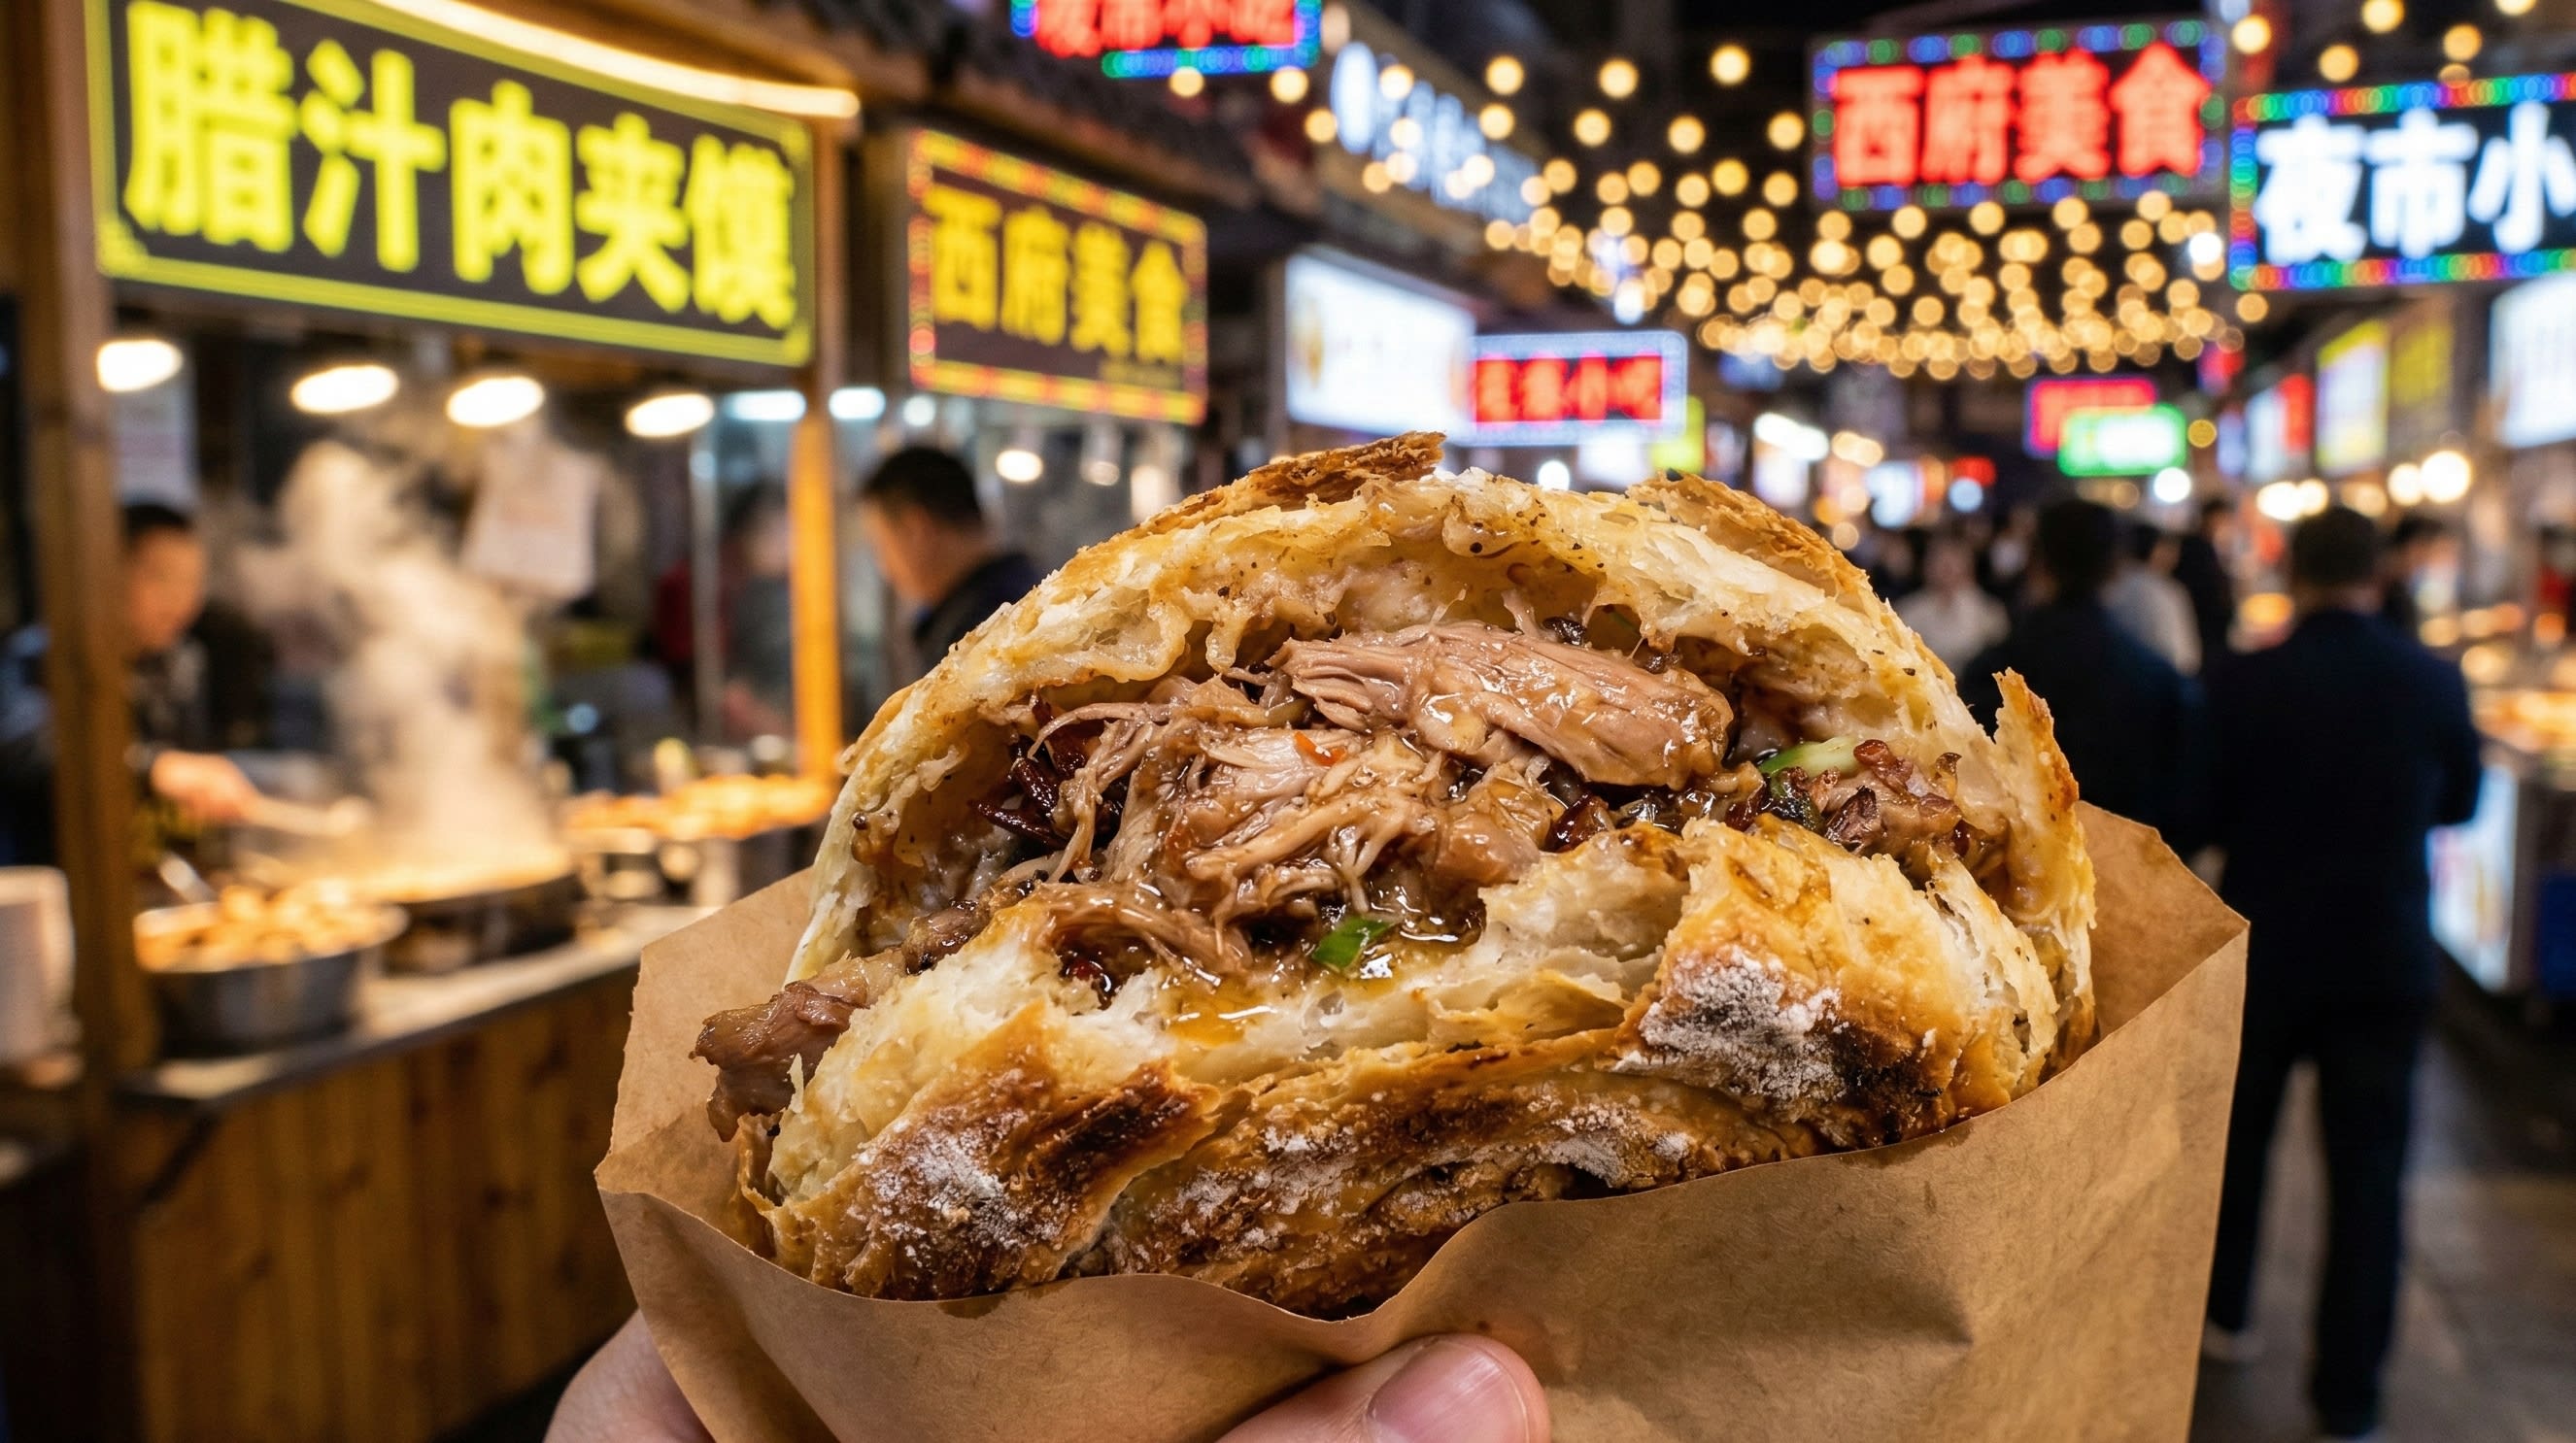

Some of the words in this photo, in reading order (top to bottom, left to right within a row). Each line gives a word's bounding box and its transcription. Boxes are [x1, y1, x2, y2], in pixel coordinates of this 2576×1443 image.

[124, 1, 796, 330] 腊汁肉夹馍
[1834, 43, 2211, 186] 西府美食
[2254, 101, 2576, 266] 夜市小
[924, 185, 1186, 364] 西府美食
